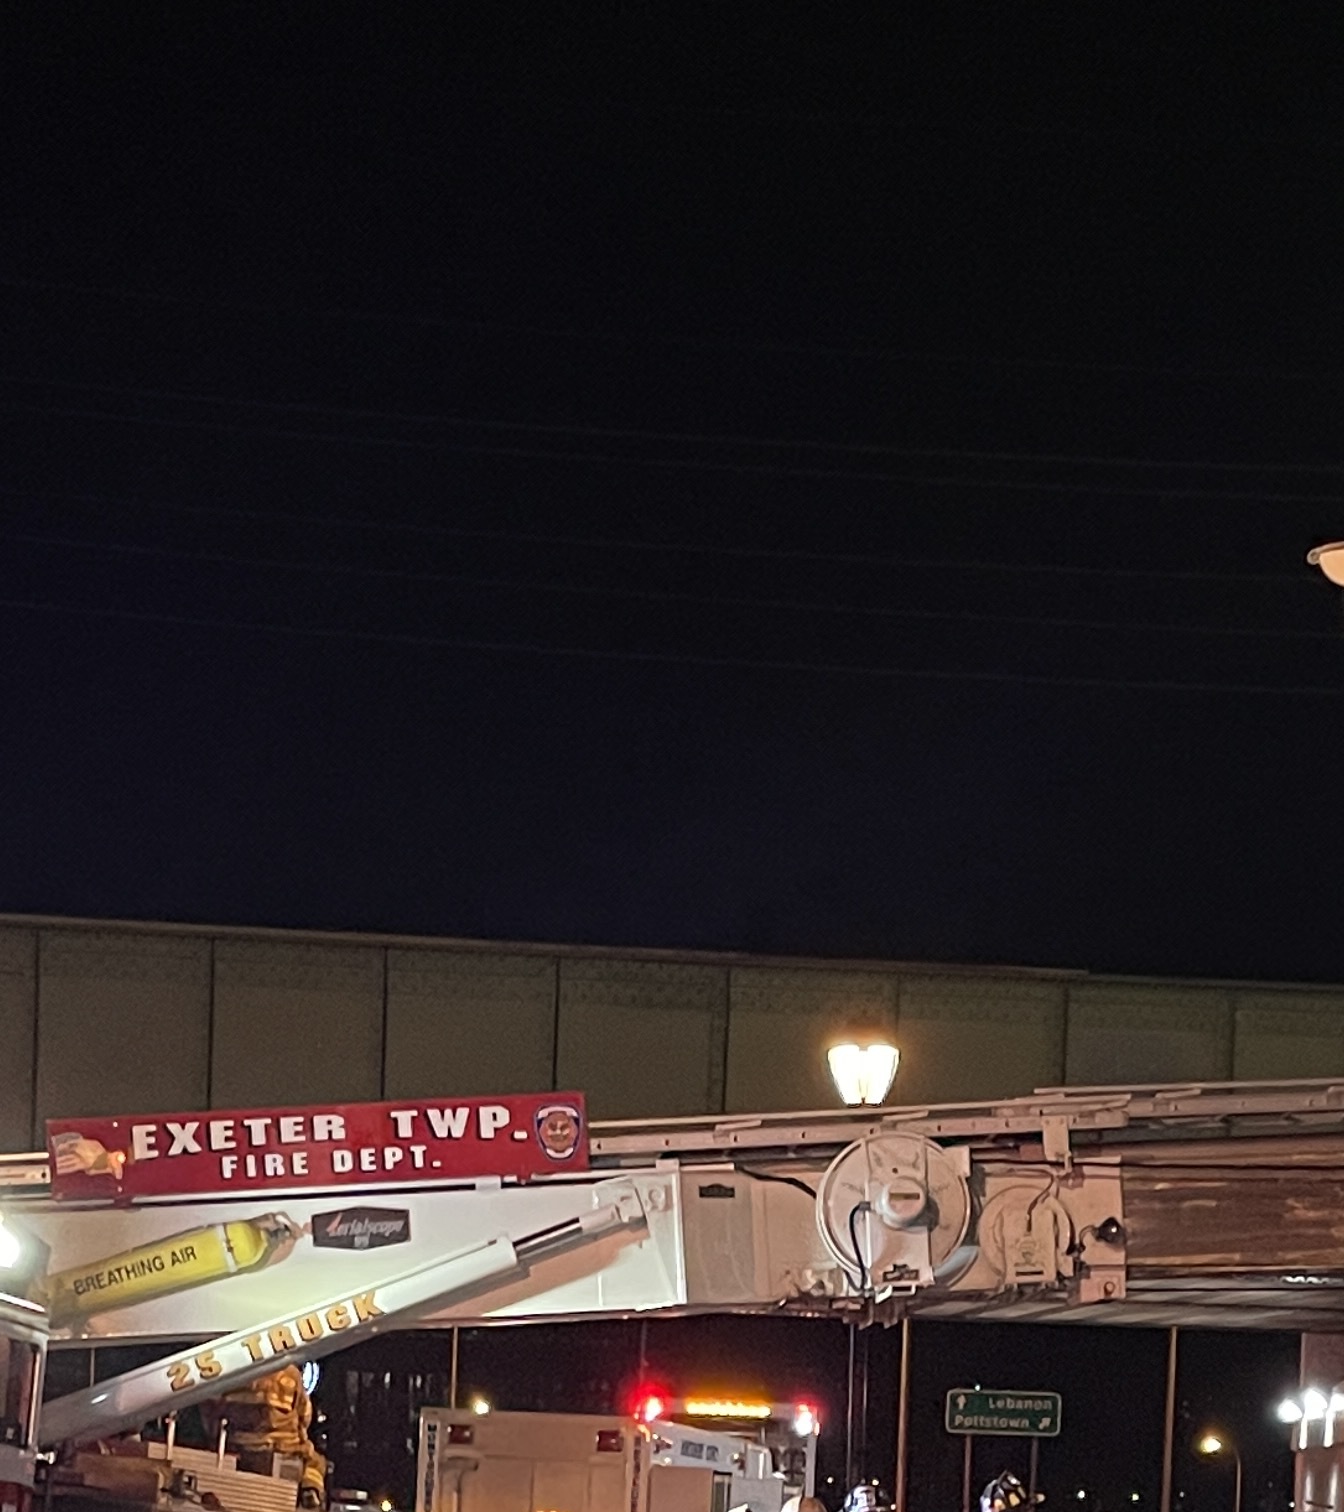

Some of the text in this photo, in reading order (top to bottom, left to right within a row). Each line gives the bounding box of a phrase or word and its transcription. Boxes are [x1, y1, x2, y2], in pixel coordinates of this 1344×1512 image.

[131, 1104, 529, 1161] EXETER TWP.
[220, 1144, 442, 1179] FIRE DEPT.
[72, 1245, 197, 1296] BREATHING AIR
[166, 1289, 387, 1393] 25 TRUCK
[954, 1414, 1030, 1429] Pottstown
[988, 1396, 1053, 1410] Lebanon
